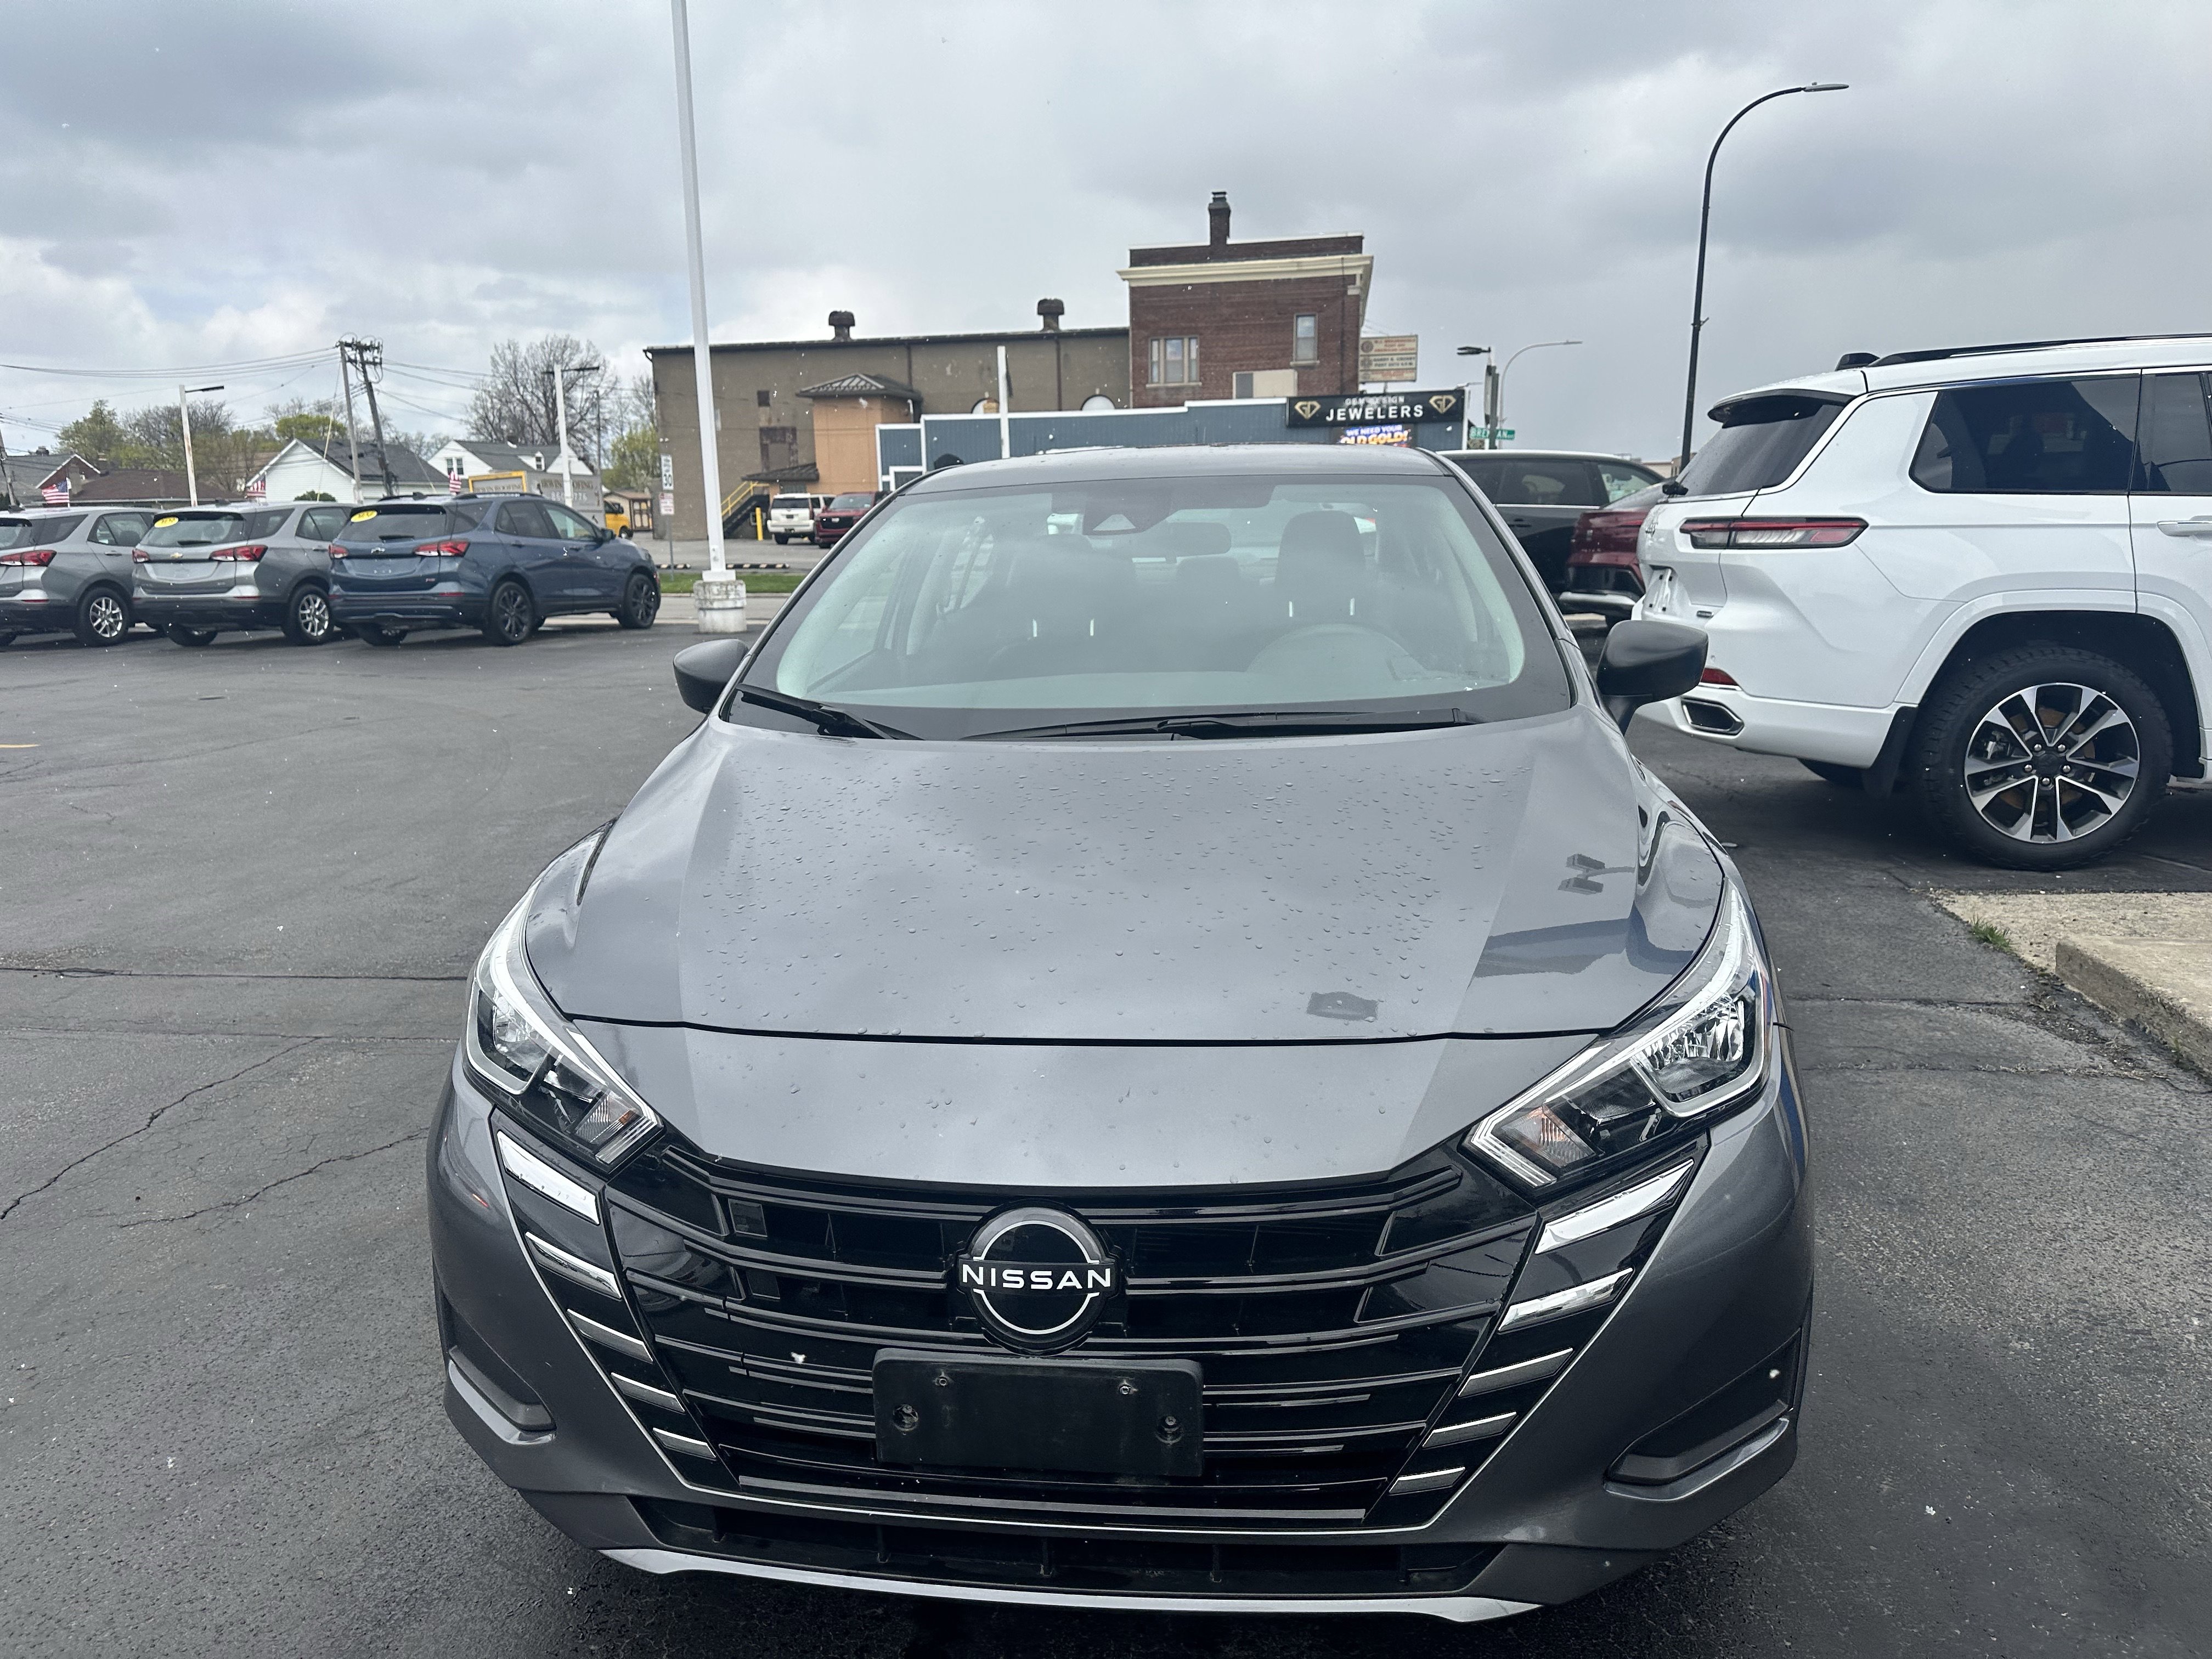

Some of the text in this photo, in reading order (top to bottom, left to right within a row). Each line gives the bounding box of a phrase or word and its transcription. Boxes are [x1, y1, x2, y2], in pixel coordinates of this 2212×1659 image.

[1325, 404, 1423, 421] JEWELERS
[664, 473, 672, 487] 30
[962, 1264, 1111, 1290] NISSAN
